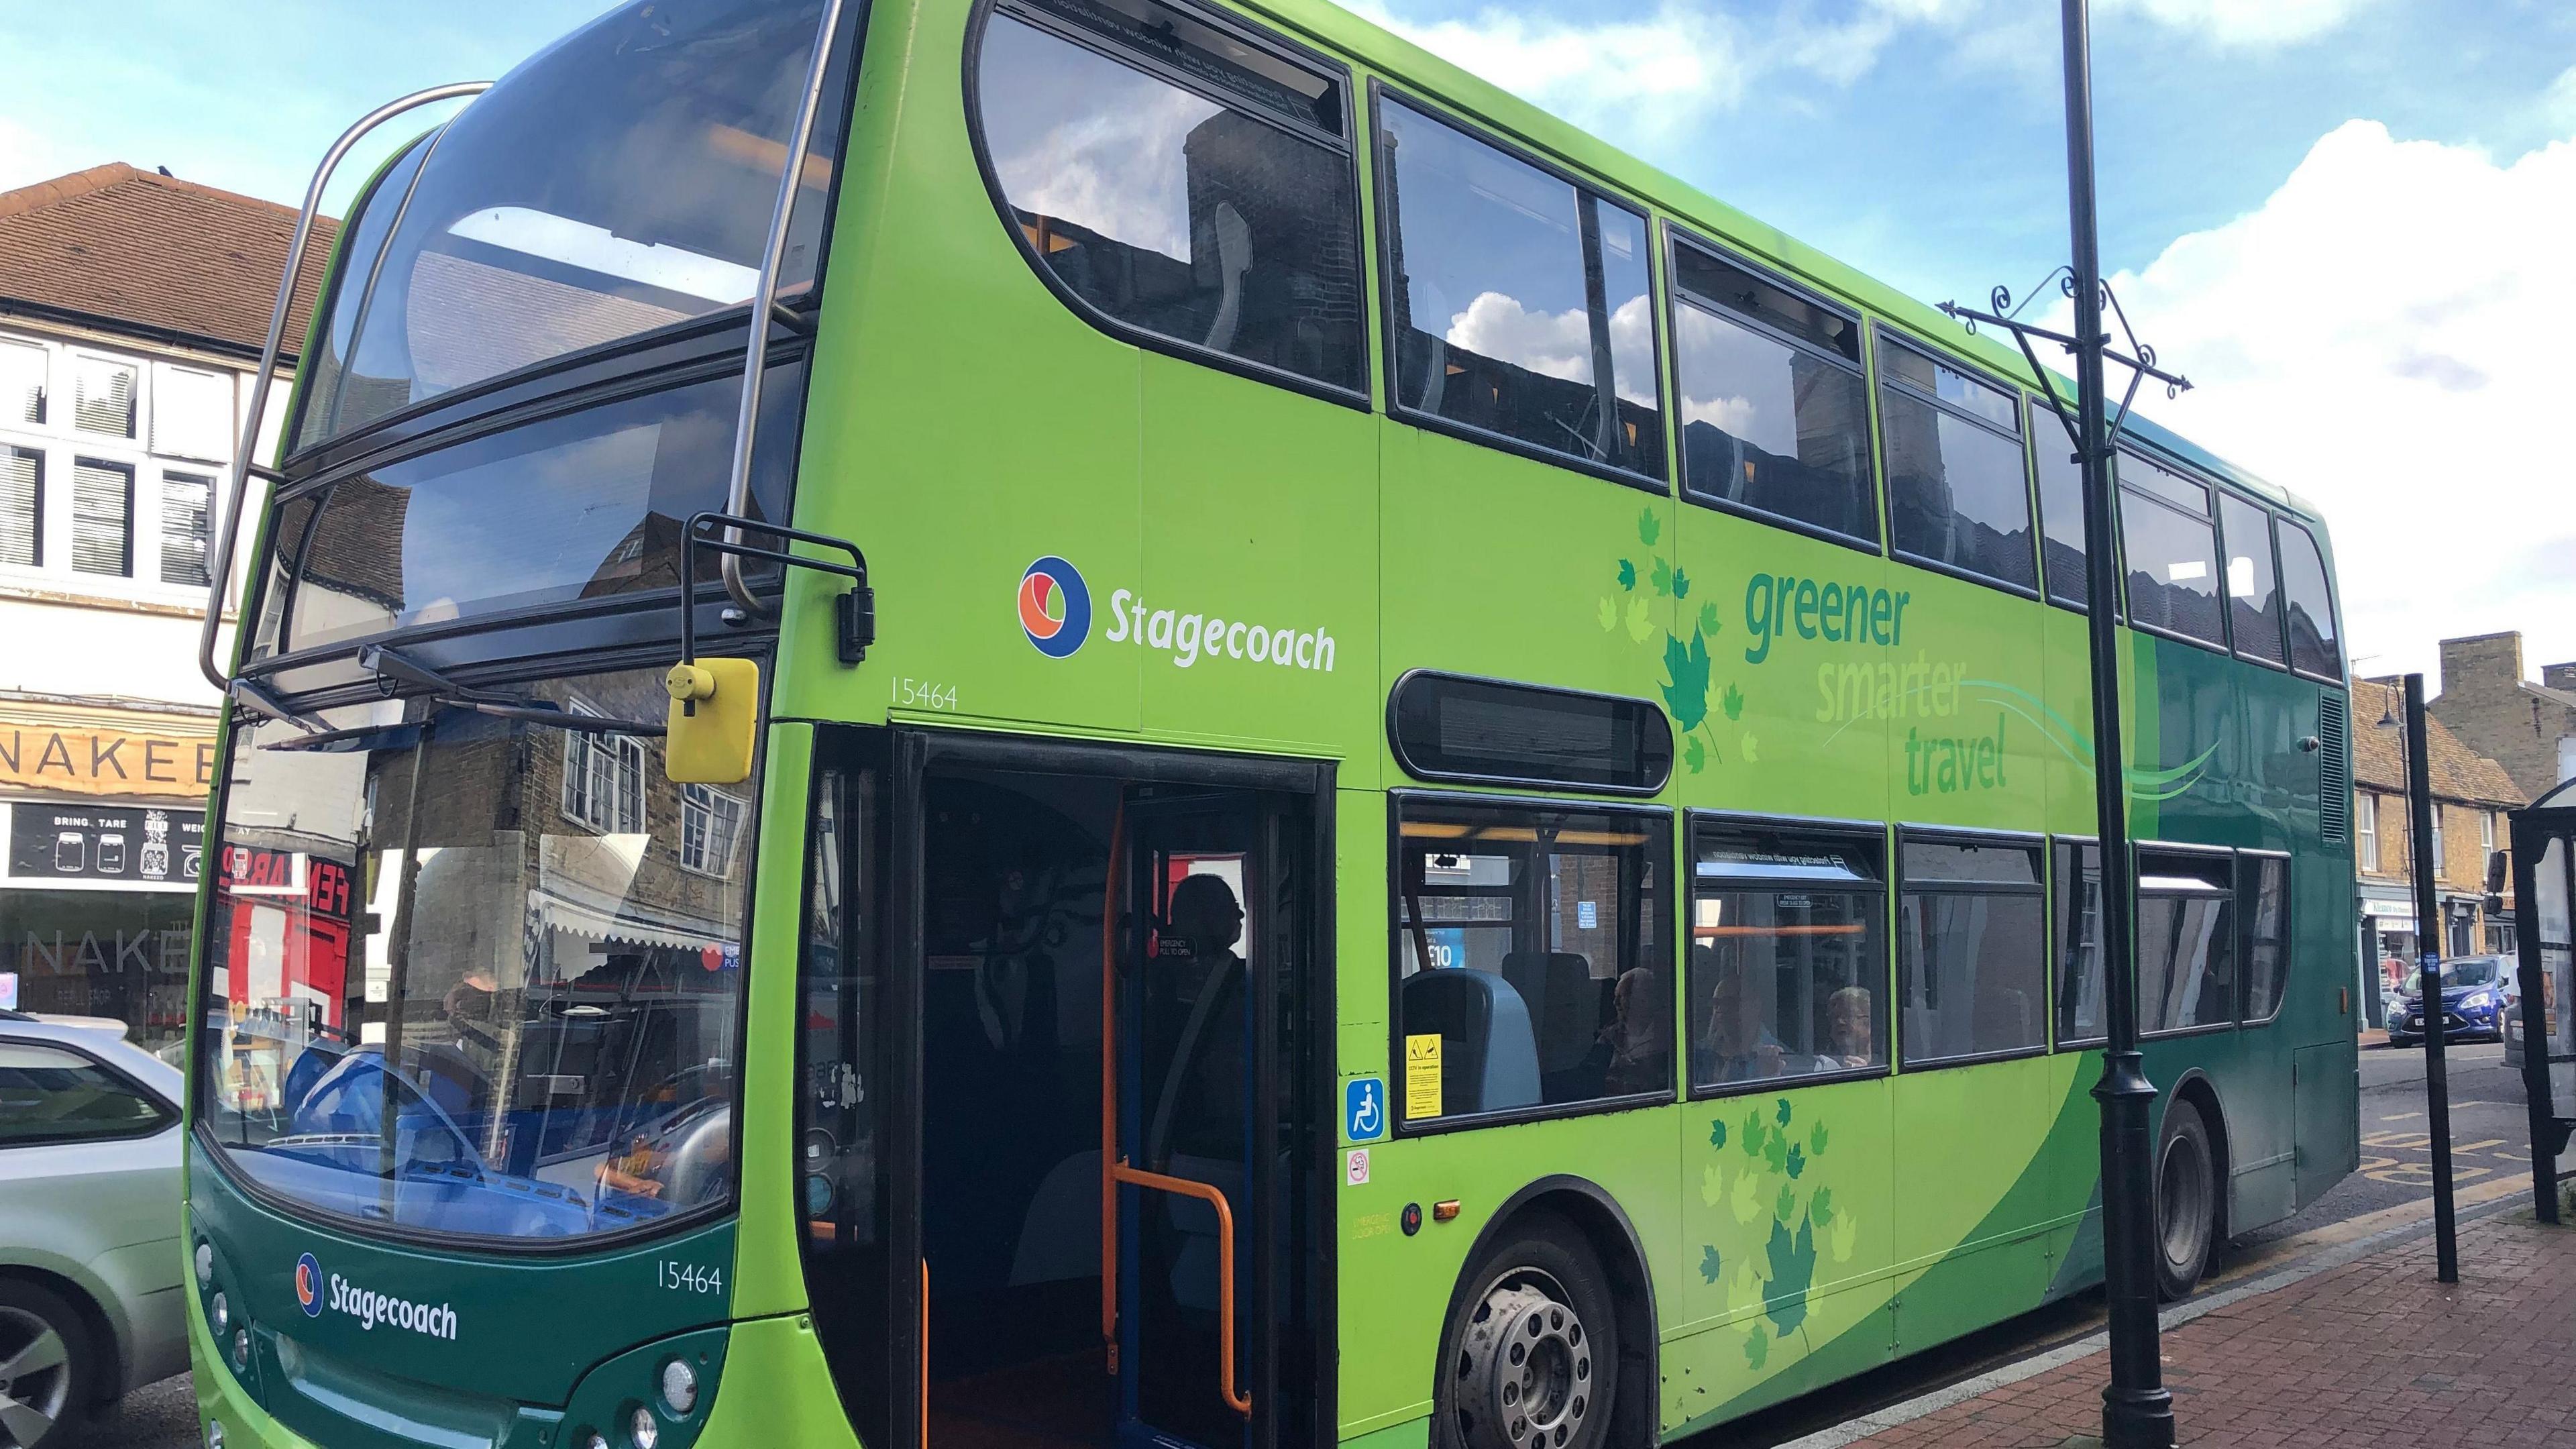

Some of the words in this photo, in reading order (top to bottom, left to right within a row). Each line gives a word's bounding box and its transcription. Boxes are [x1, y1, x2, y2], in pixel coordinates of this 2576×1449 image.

[1106, 588, 1336, 672] Stagecoach
[1746, 574, 1911, 664] greener
[892, 677, 958, 710] 15464
[1815, 649, 1967, 722] smarter
[1905, 712, 2006, 796] travel
[54, 816, 89, 826] BRING
[99, 819, 127, 828] TARE
[329, 1273, 456, 1340] Stagecoach
[659, 1260, 722, 1295] 15464
